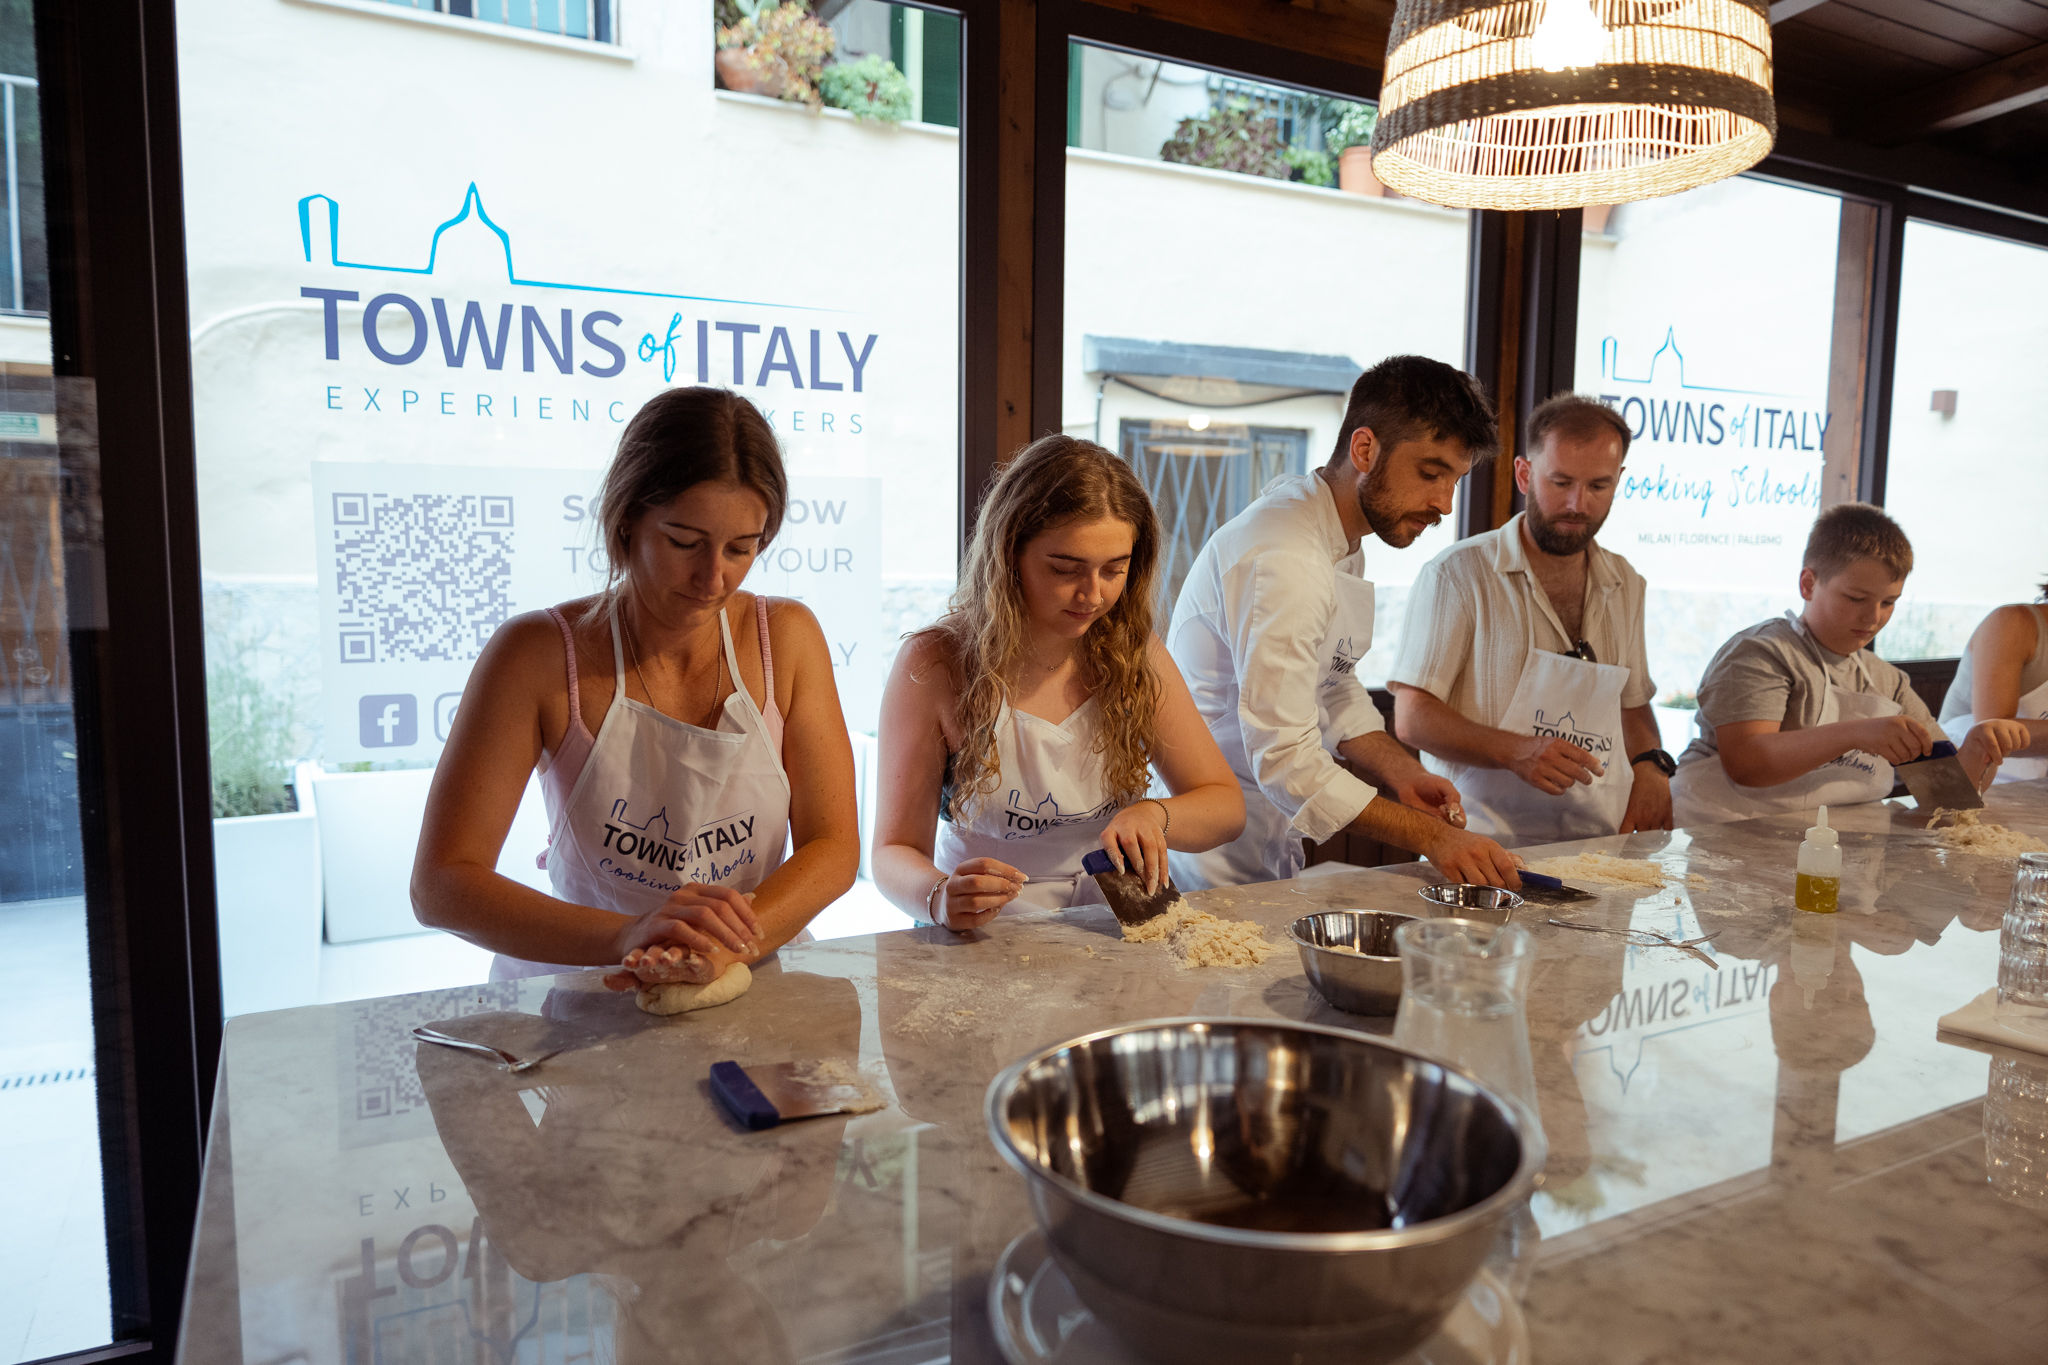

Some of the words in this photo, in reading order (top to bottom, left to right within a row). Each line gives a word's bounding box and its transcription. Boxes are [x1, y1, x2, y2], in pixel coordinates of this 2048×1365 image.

[300, 286, 626, 378] TOWNS
[637, 312, 683, 383] of
[697, 320, 879, 393] ITALY
[326, 385, 627, 424] EXPERIENC
[763, 409, 863, 434] KERS
[1730, 403, 1750, 448] of
[1754, 407, 1832, 451] ITALY
[784, 499, 847, 525] OW
[1615, 464, 1714, 518] ooking
[1727, 465, 1821, 508] Schools
[759, 547, 853, 573] YOUR
[1638, 533, 1671, 545] MILAN
[1679, 533, 1730, 545] FLORENCE
[1737, 534, 1783, 546] PALERMO
[603, 824, 687, 871] TOWNS
[694, 815, 755, 858] ITALY
[690, 848, 756, 885] Schools
